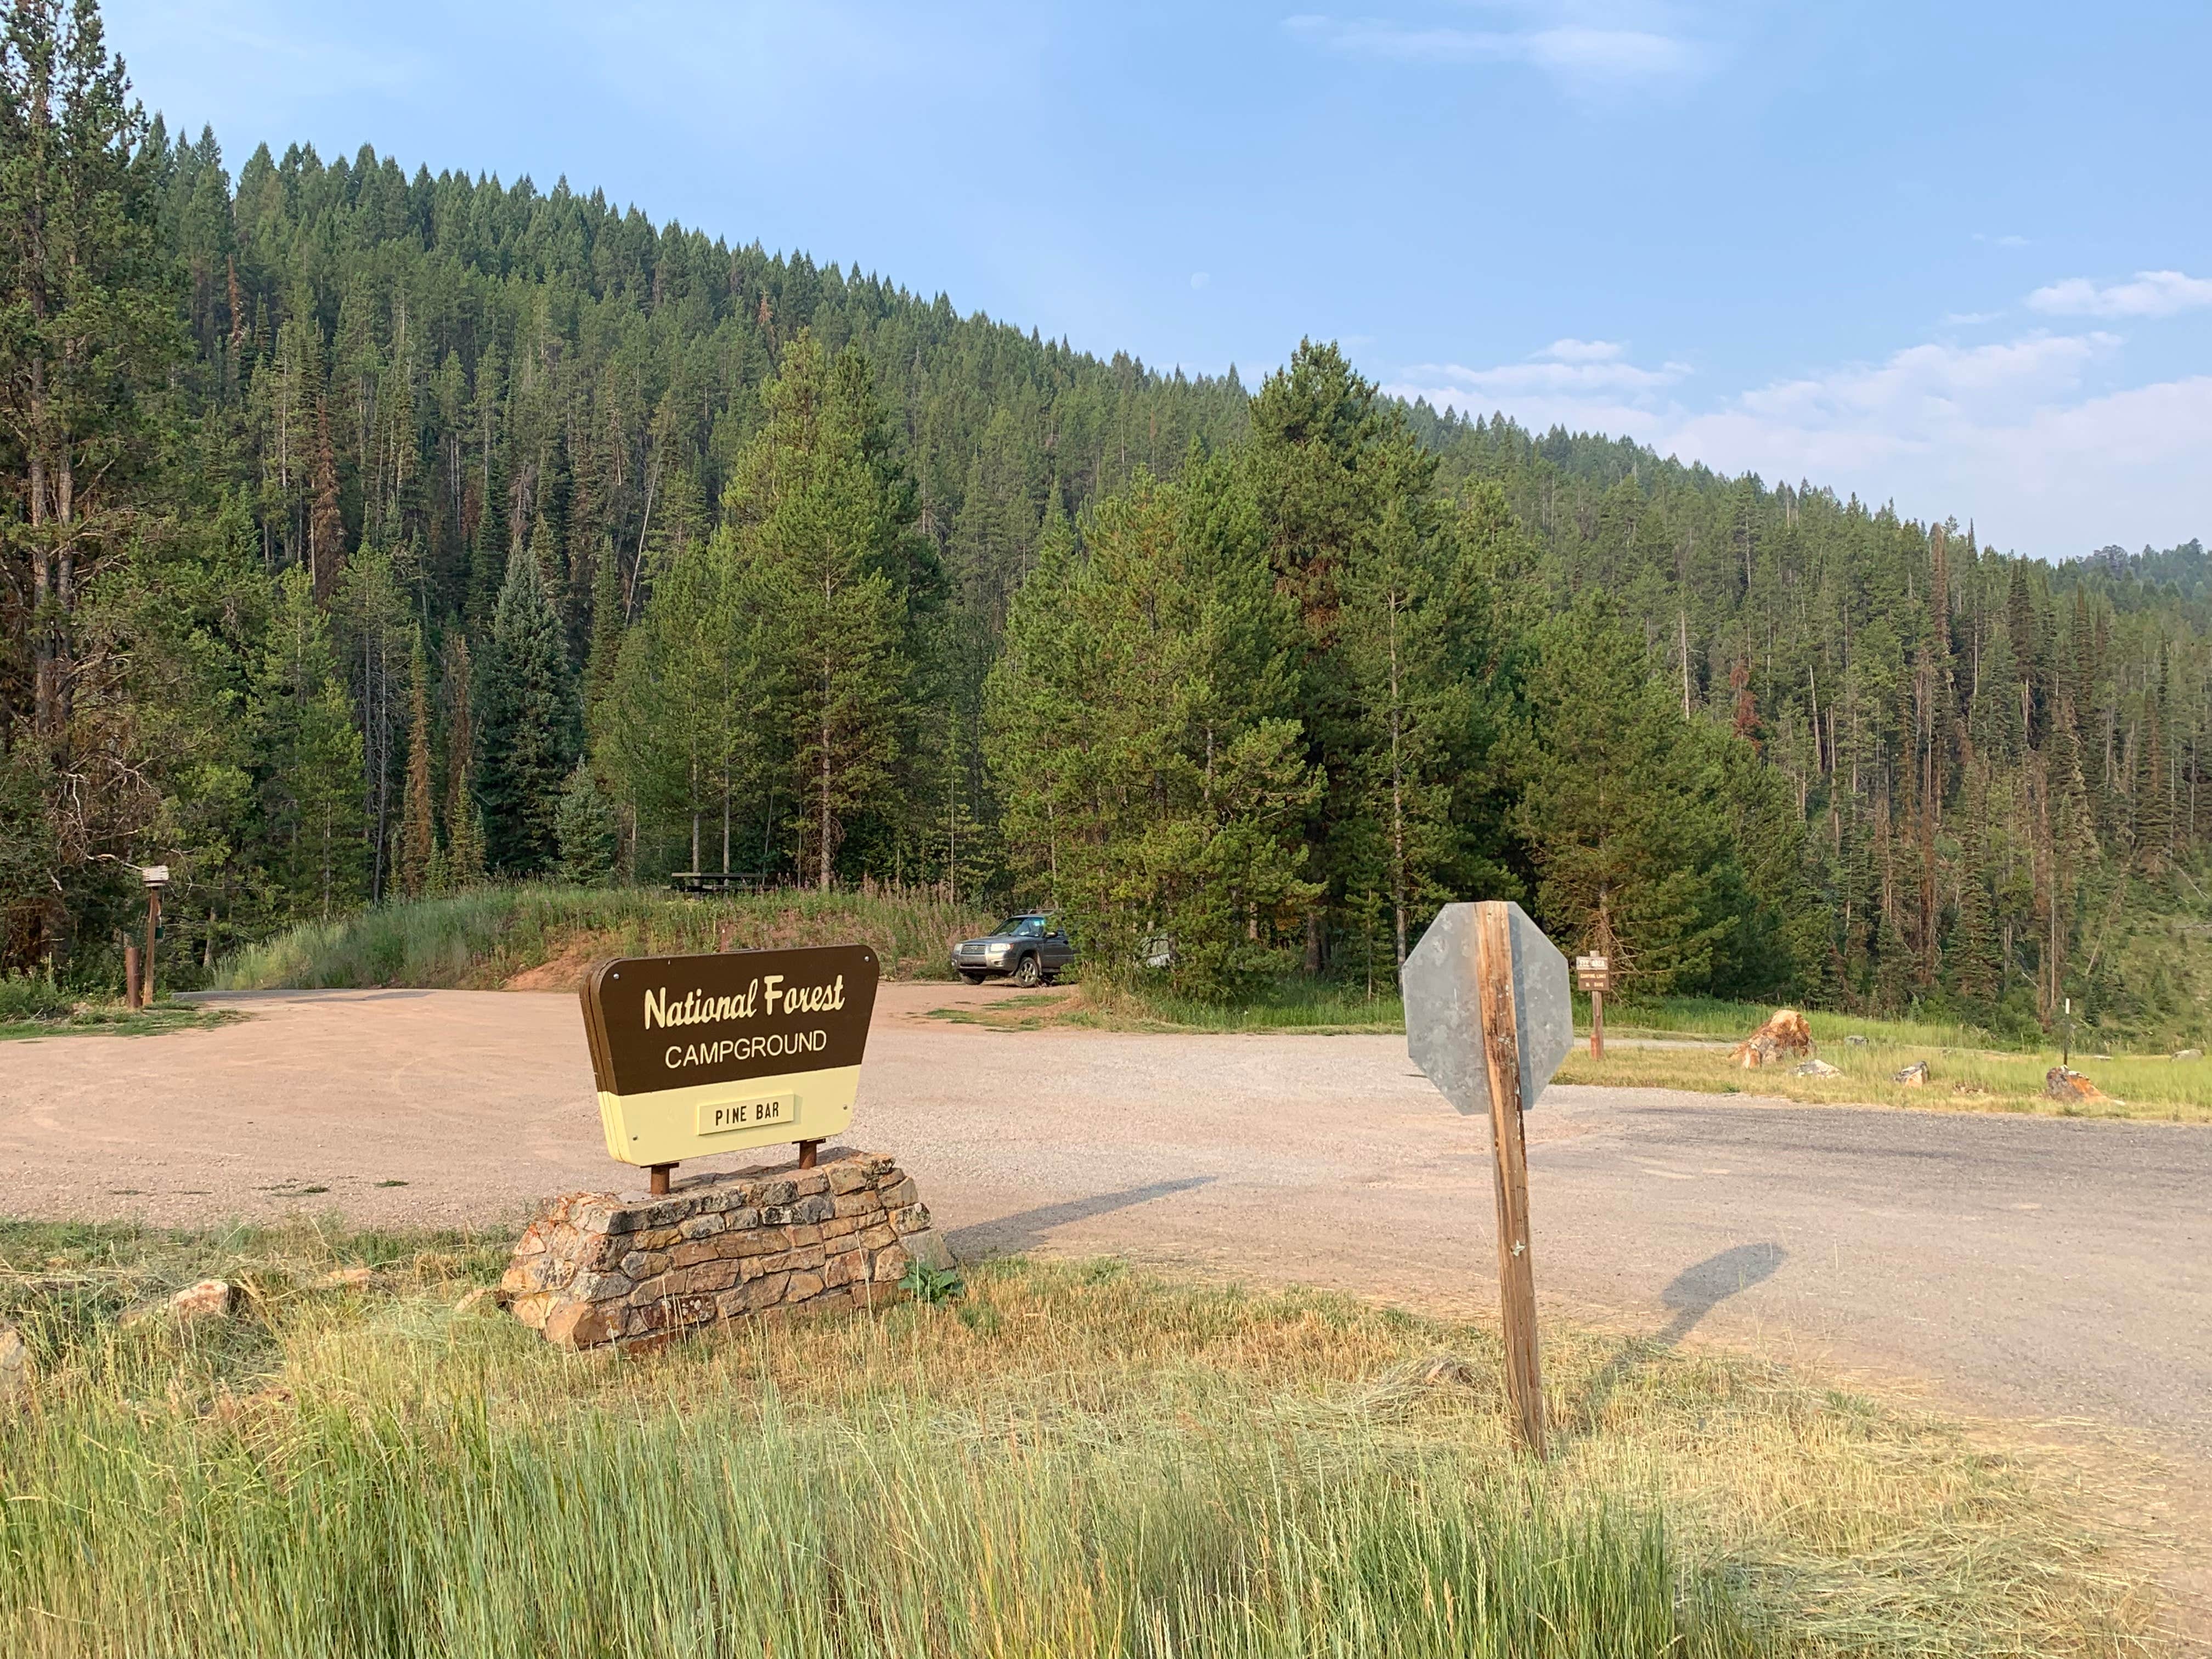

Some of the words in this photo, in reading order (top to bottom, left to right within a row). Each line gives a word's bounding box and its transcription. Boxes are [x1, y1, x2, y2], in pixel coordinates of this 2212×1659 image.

[644, 978, 757, 1030] National
[764, 974, 845, 1015] Forest
[665, 1030, 827, 1068] CAMPGROUND
[715, 1105, 747, 1126] PINE
[756, 1102, 779, 1120] BAR
